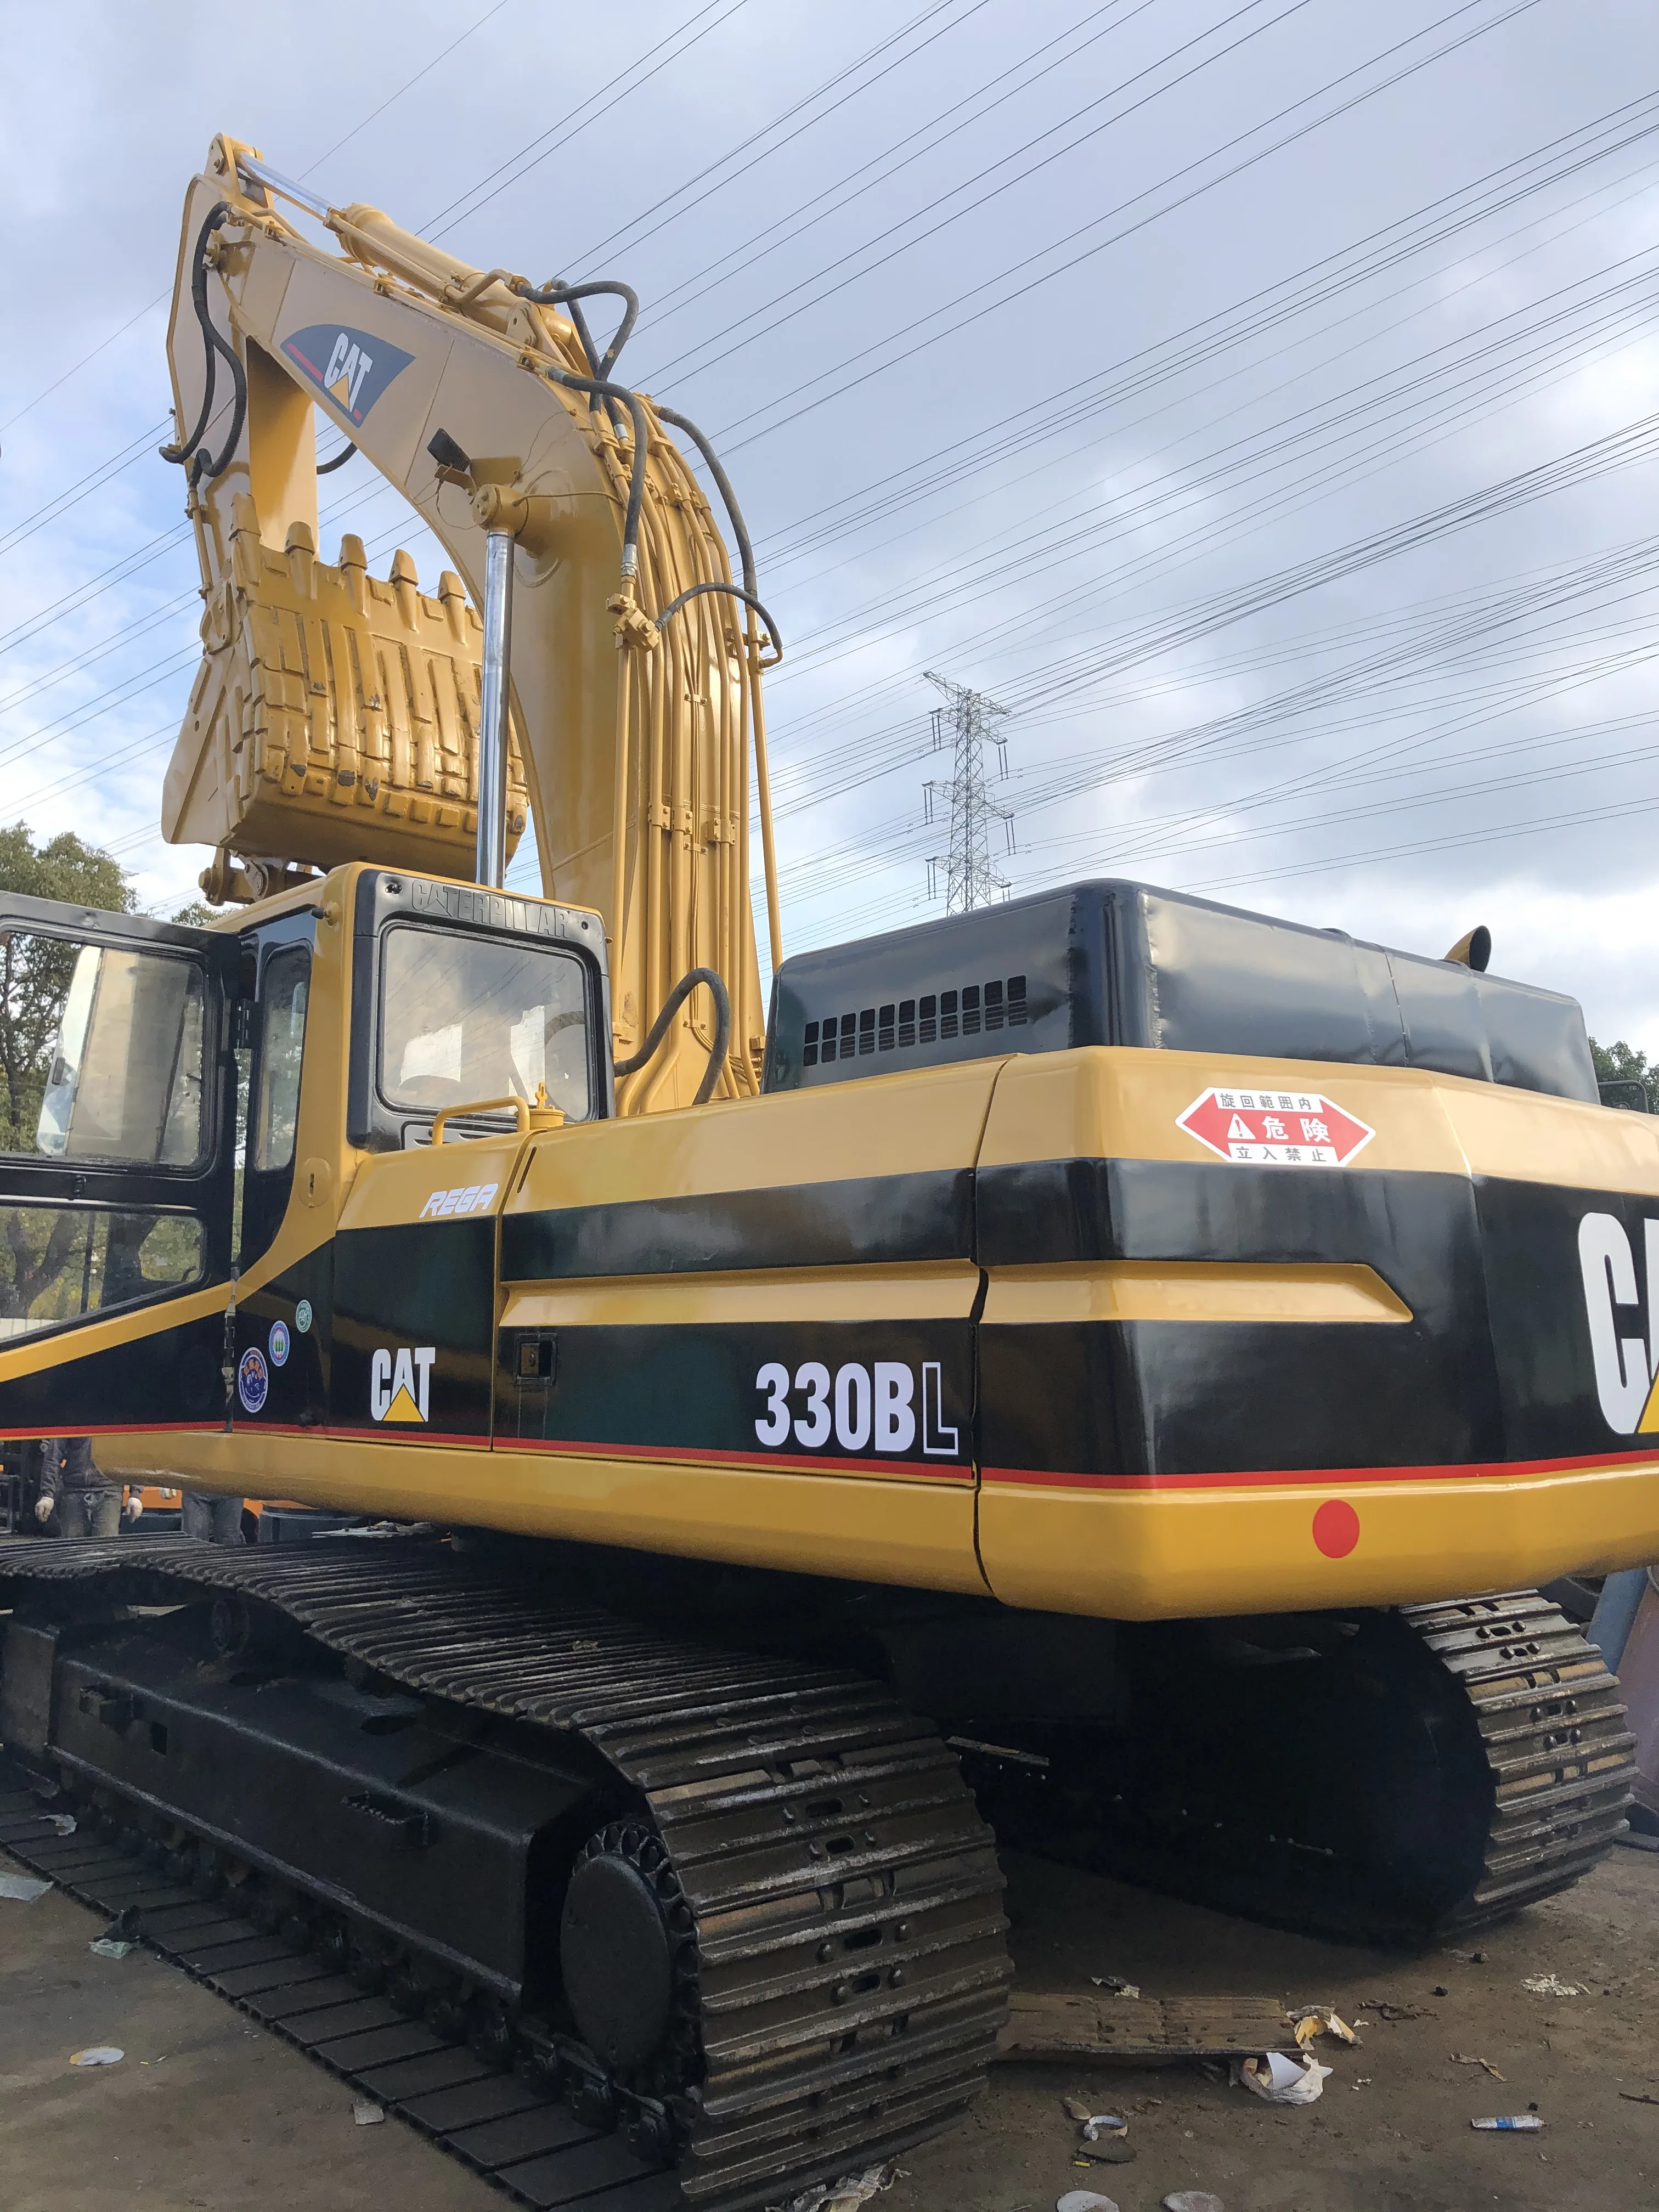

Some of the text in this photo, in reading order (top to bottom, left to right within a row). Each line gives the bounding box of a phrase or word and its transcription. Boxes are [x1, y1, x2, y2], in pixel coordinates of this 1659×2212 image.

[324, 332, 373, 413] CAT
[411, 879, 570, 939] CATERPILLAR
[1220, 1093, 1312, 1110] 旋回範囲内
[1261, 1115, 1331, 1143] 危険
[1236, 1146, 1327, 1163] 立入禁止
[419, 1183, 498, 1218] REGA
[1578, 1212, 1659, 1434] C
[371, 1347, 436, 1421] CAT
[755, 1362, 958, 1455] 330BL
